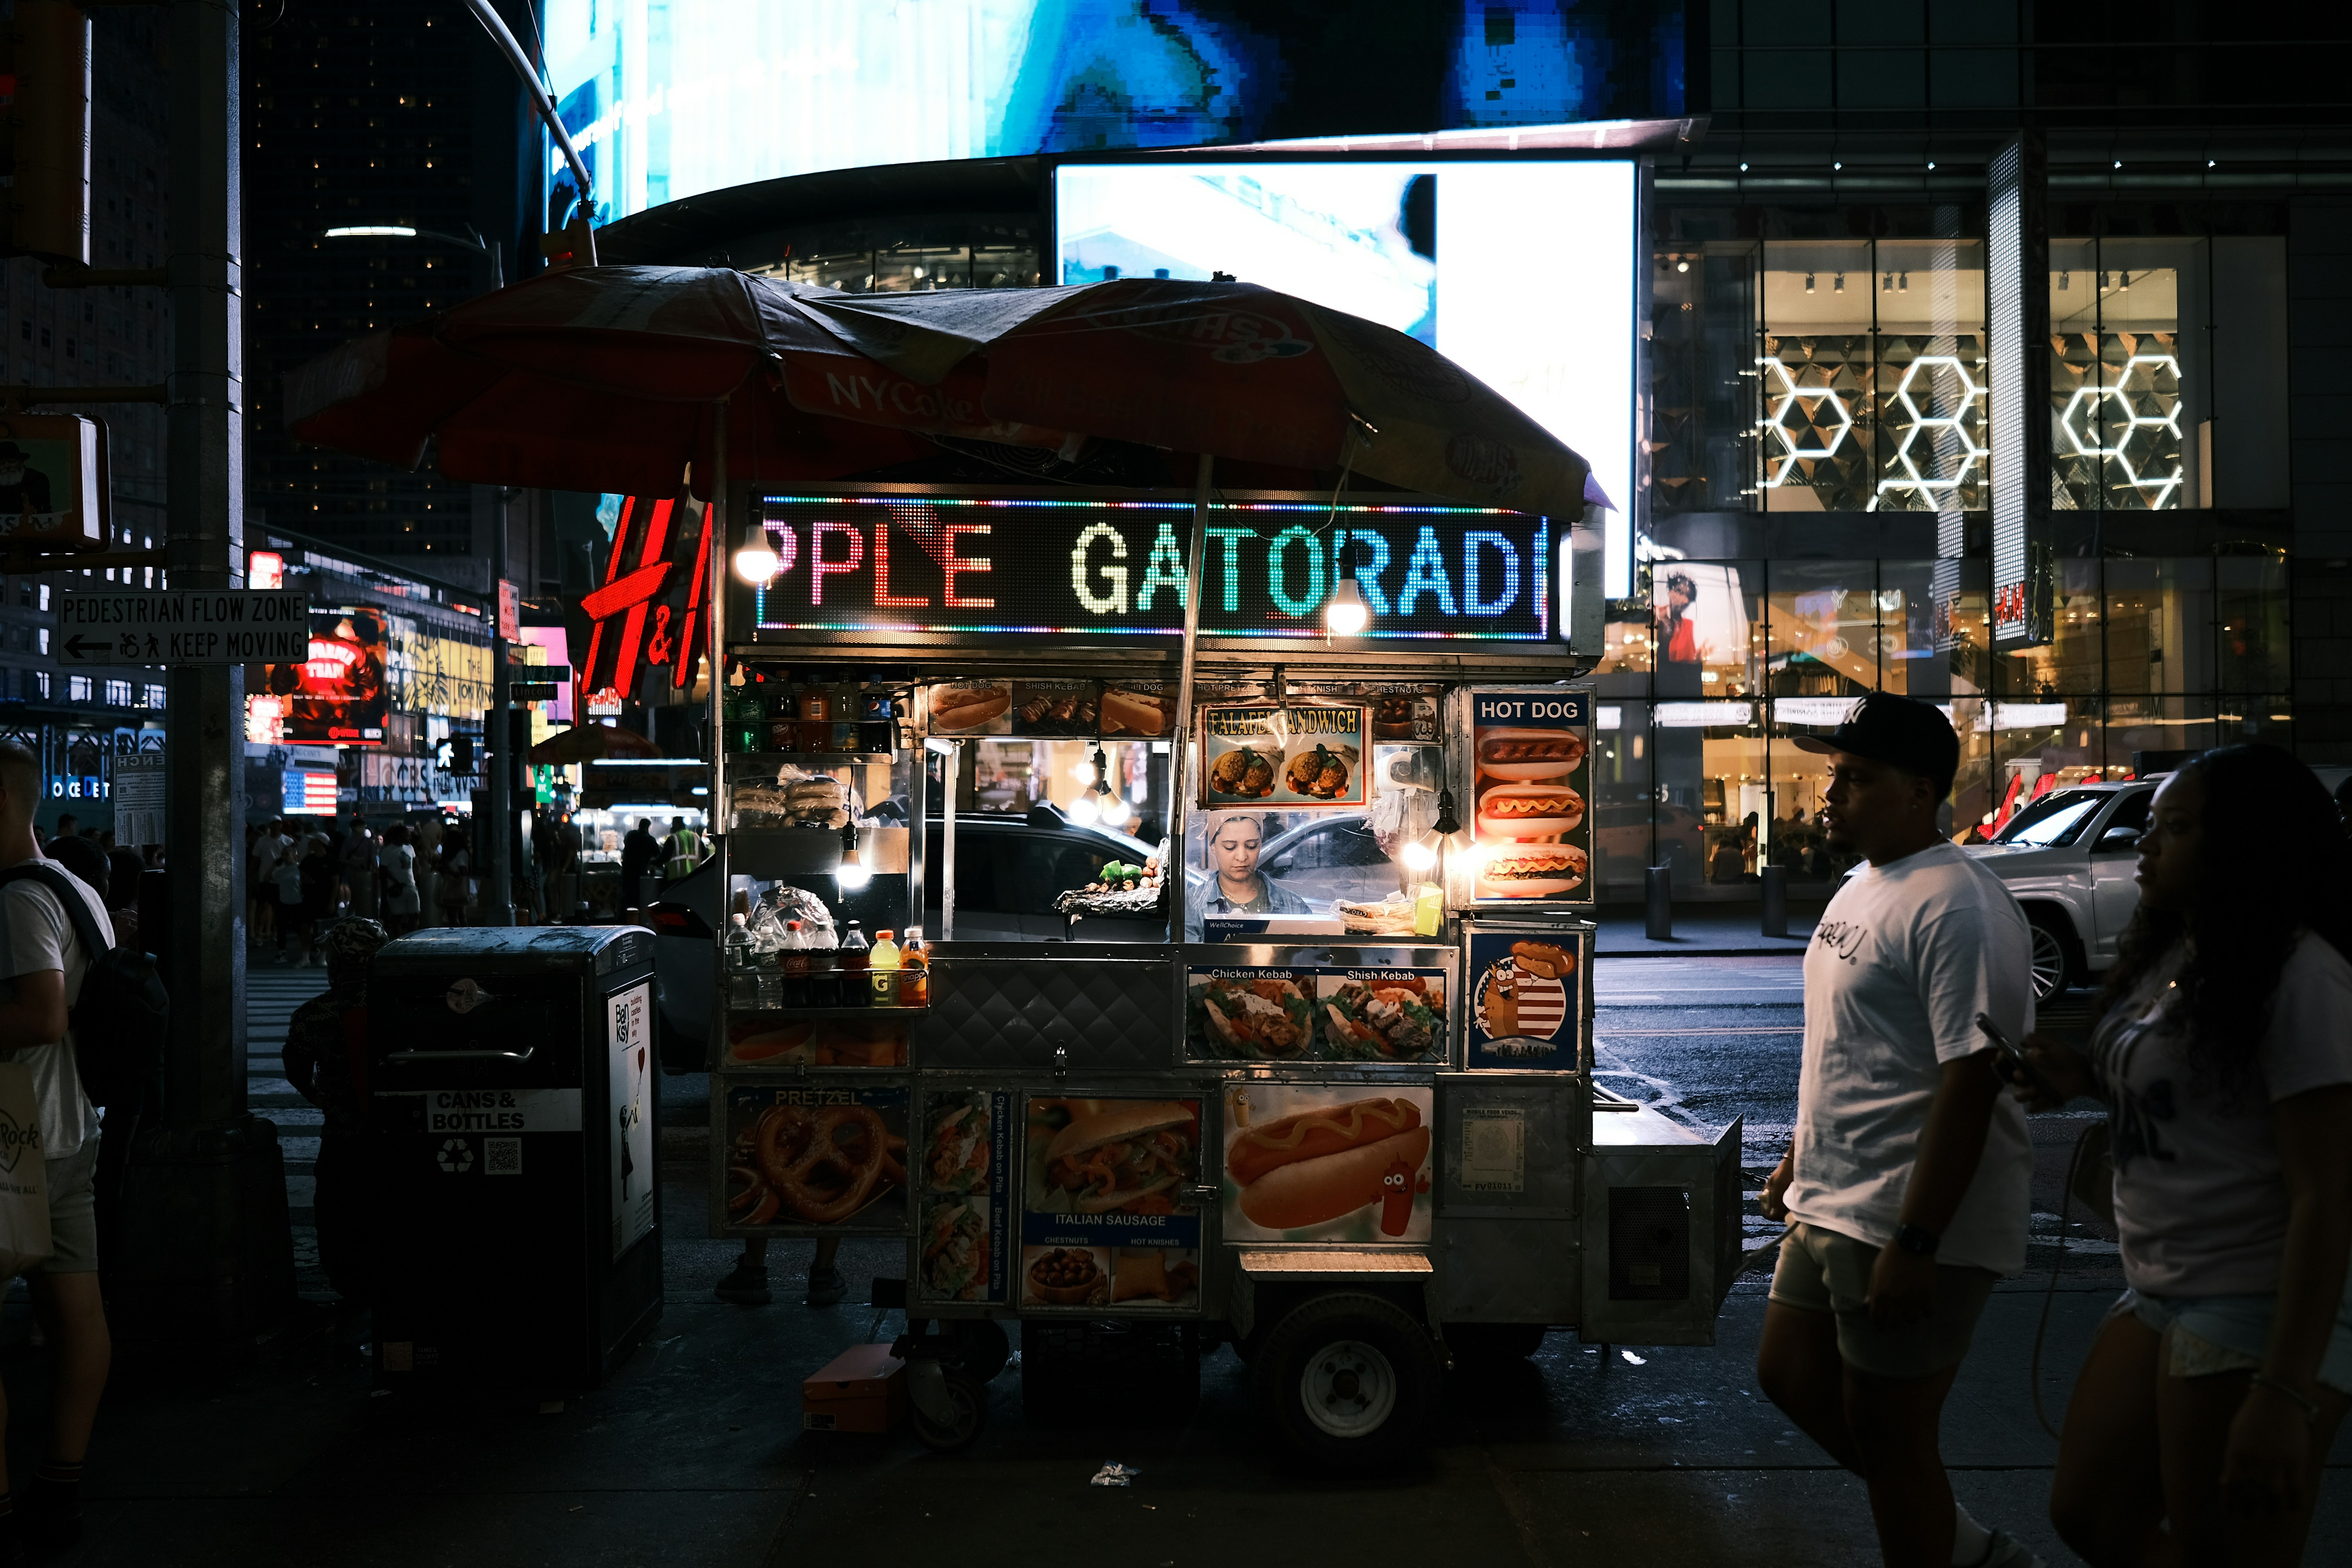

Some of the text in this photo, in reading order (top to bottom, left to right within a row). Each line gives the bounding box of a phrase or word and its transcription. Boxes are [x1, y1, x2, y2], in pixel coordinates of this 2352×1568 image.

[1072, 522, 1546, 616] GATORAD
[64, 597, 303, 623] PEDESTRIAN FLOW ZONE
[171, 632, 302, 657] KEEP MOVING
[467, 660, 481, 673] THE
[525, 669, 536, 678] W
[542, 669, 555, 679] 42
[515, 687, 554, 696] Lincoln
[973, 681, 992, 689] DOG
[1143, 683, 1164, 692] DOG
[1197, 684, 1259, 693] HOT PRETZEL
[476, 680, 492, 709] KIN
[1482, 701, 1578, 718] HOT DOG
[1210, 709, 1357, 735] FALAFEL SANDWICH
[1352, 909, 1367, 917] GYRO
[1211, 969, 1292, 980] Chicken Kebab
[1347, 970, 1415, 981] Shish Kebab
[874, 974, 888, 992] G
[630, 995, 642, 1006] building
[616, 1003, 629, 1024] Ban
[631, 1006, 641, 1017] castles
[616, 1020, 629, 1044] ksy
[437, 1092, 516, 1108] CANS &
[775, 1090, 862, 1106] PRETZEL
[433, 1113, 525, 1129] BOTTLES
[996, 1096, 1005, 1131] Chicken
[995, 1133, 1004, 1161] Kebab
[995, 1162, 1001, 1173] on
[994, 1207, 1002, 1228] Beef
[1055, 1214, 1166, 1227] ITALIAN SAUSAGE
[994, 1230, 1002, 1258] Kebab
[994, 1259, 999, 1271] on
